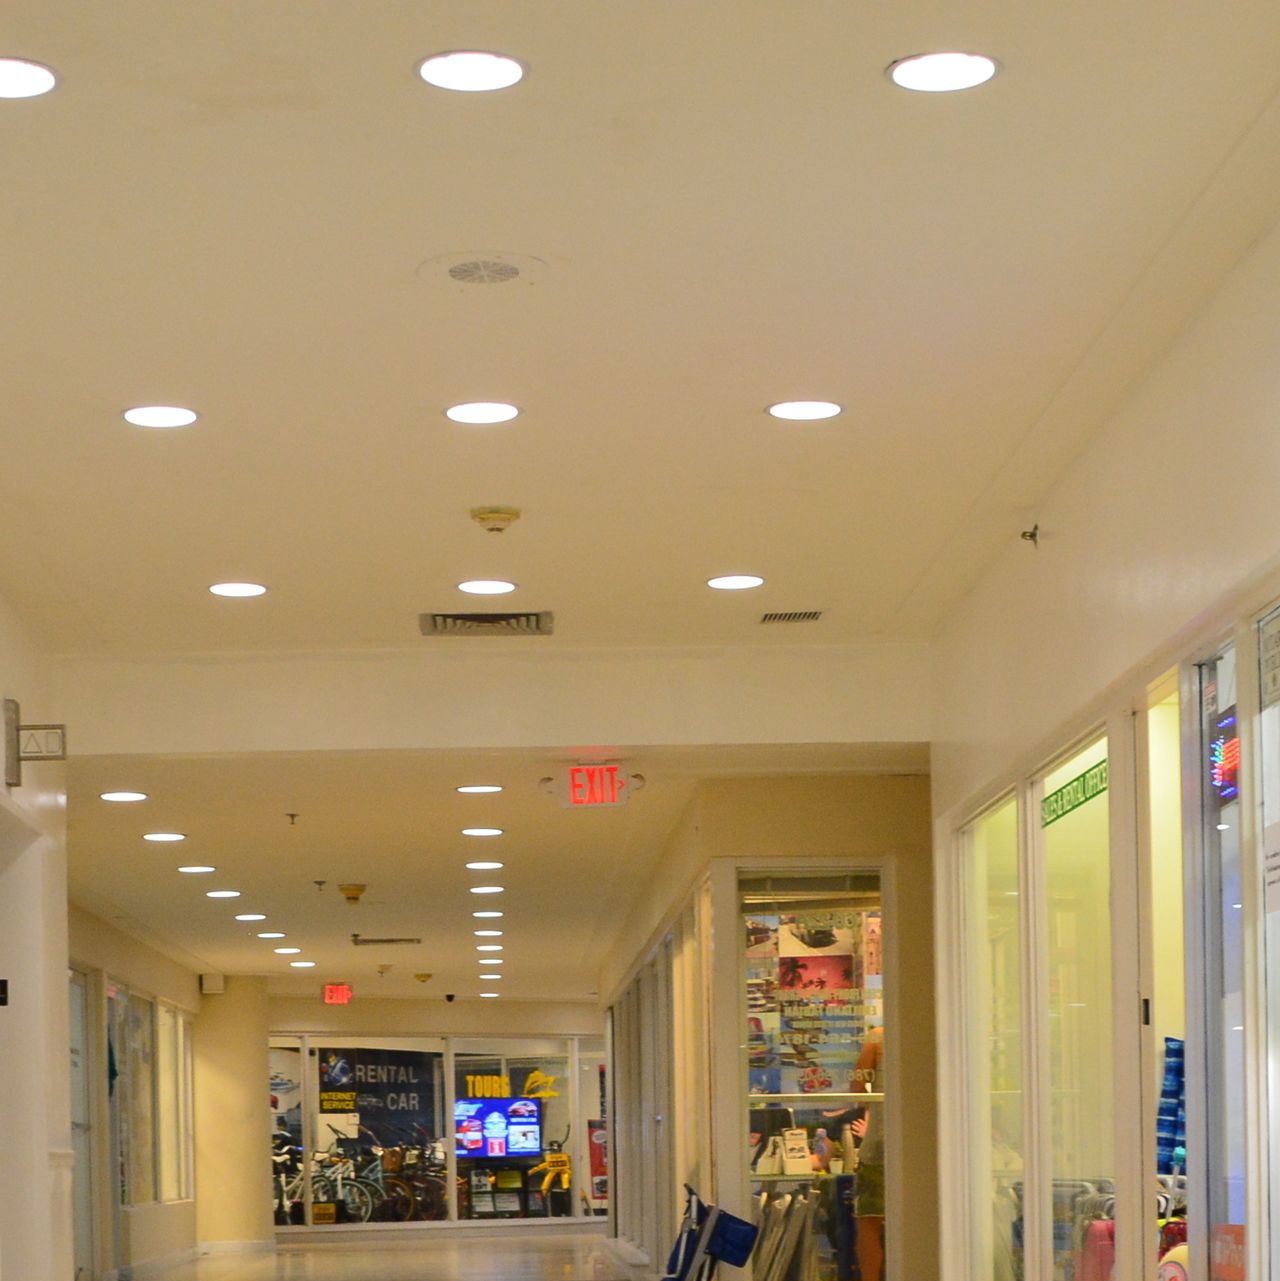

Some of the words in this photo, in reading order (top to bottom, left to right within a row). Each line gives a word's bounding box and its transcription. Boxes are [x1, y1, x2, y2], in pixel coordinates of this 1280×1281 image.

[569, 766, 618, 805] EXIT
[355, 1064, 420, 1084] RENTAL
[465, 1075, 511, 1097] TOURS
[387, 1093, 420, 1110] CAR
